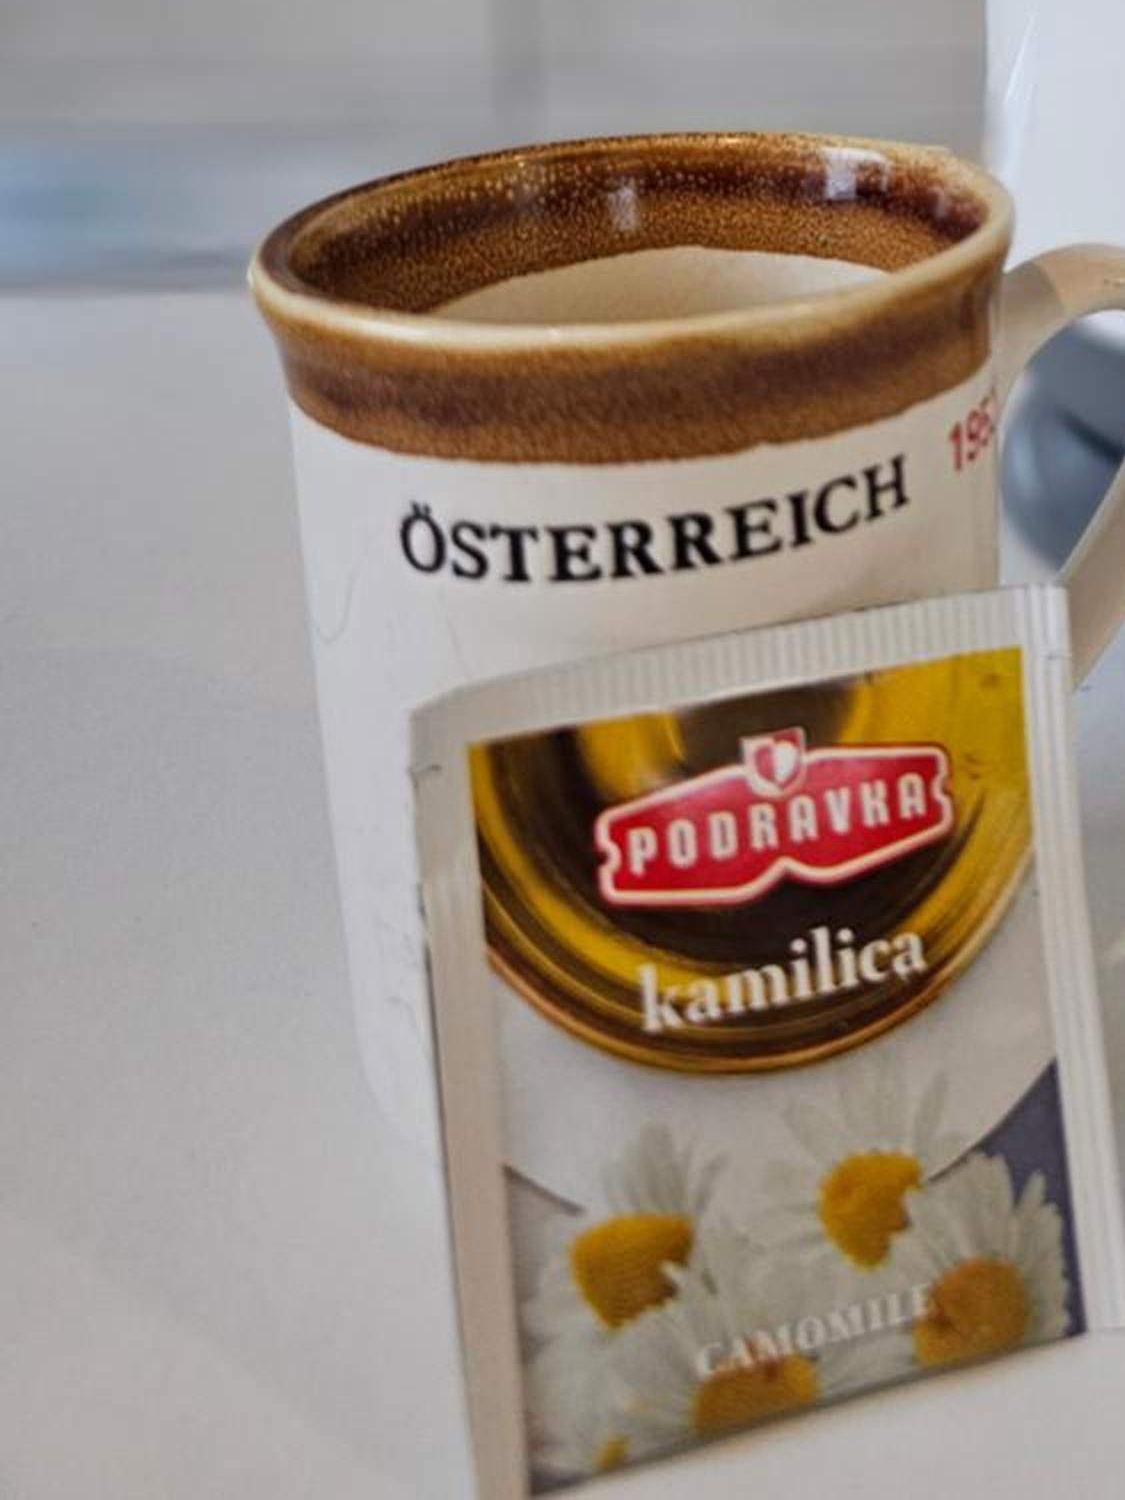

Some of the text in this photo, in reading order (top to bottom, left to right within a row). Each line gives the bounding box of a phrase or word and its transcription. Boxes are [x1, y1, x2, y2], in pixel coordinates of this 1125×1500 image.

[399, 454, 912, 584] ÖSTERREICH
[627, 772, 928, 876] PODRAVKA
[637, 925, 930, 1034] kamilica
[694, 1283, 933, 1377] CAMOMILE
